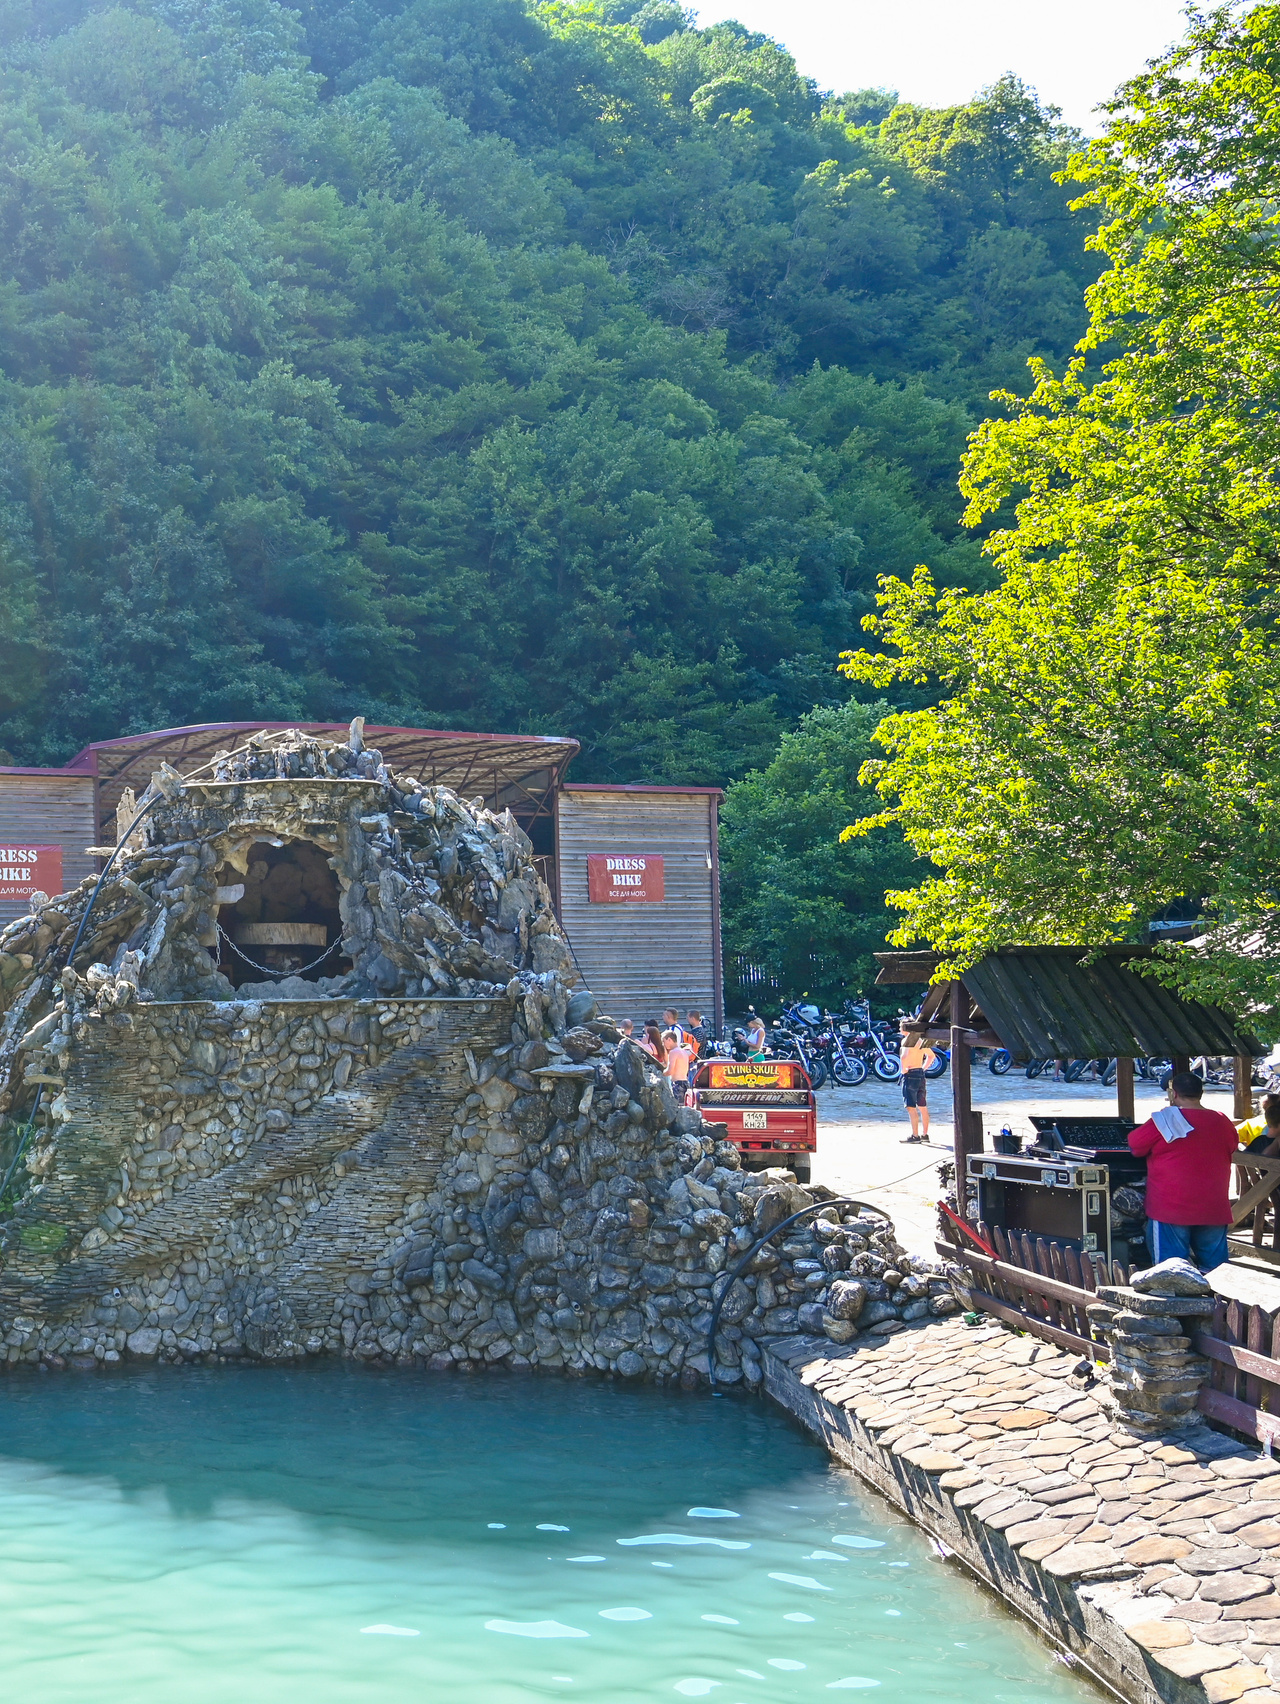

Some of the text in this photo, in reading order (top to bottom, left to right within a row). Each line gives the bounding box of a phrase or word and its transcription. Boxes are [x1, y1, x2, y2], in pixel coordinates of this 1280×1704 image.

[606, 858, 646, 870] DRESS
[612, 874, 642, 886] BIKE
[0, 886, 15, 894] ДЛЯ
[723, 1065, 780, 1075] FLYING SKULL
